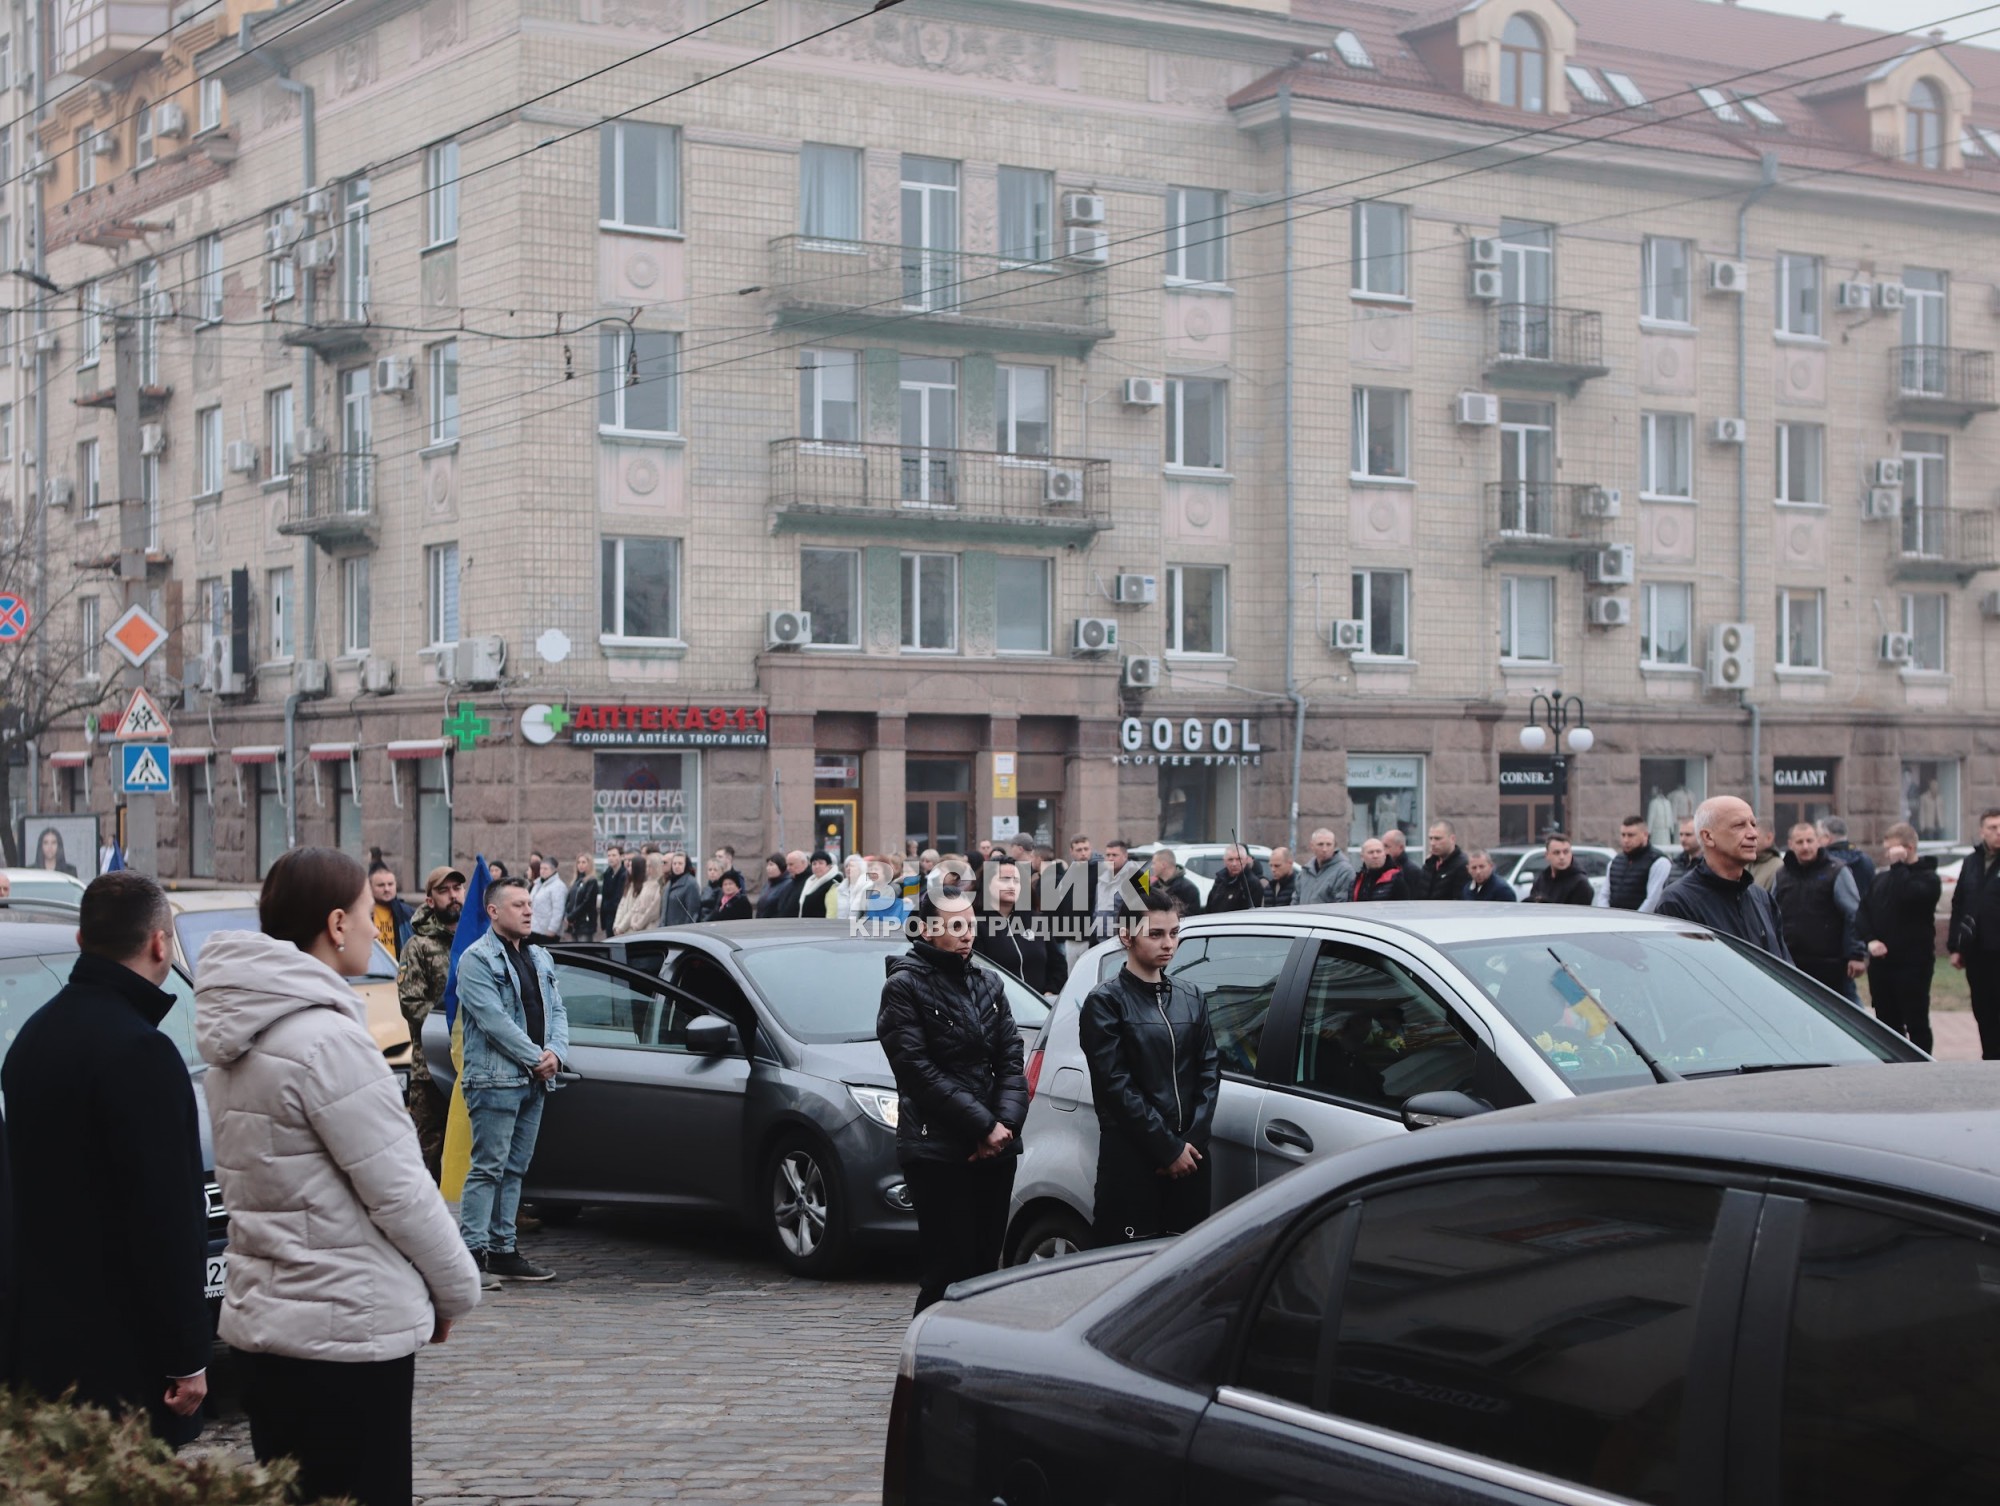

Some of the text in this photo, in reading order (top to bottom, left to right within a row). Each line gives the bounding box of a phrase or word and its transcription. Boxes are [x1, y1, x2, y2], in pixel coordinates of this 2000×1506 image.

[575, 705, 704, 730] АПТЕКА
[575, 732, 767, 744] ГОЛОВНА АПТЕКА ТВОГО МІСТА
[1122, 717, 1261, 752] GOGOL
[1121, 755, 1261, 766] COFFEE SPACE
[1775, 769, 1827, 786] GALANT
[594, 789, 685, 808] ОЛОВНА
